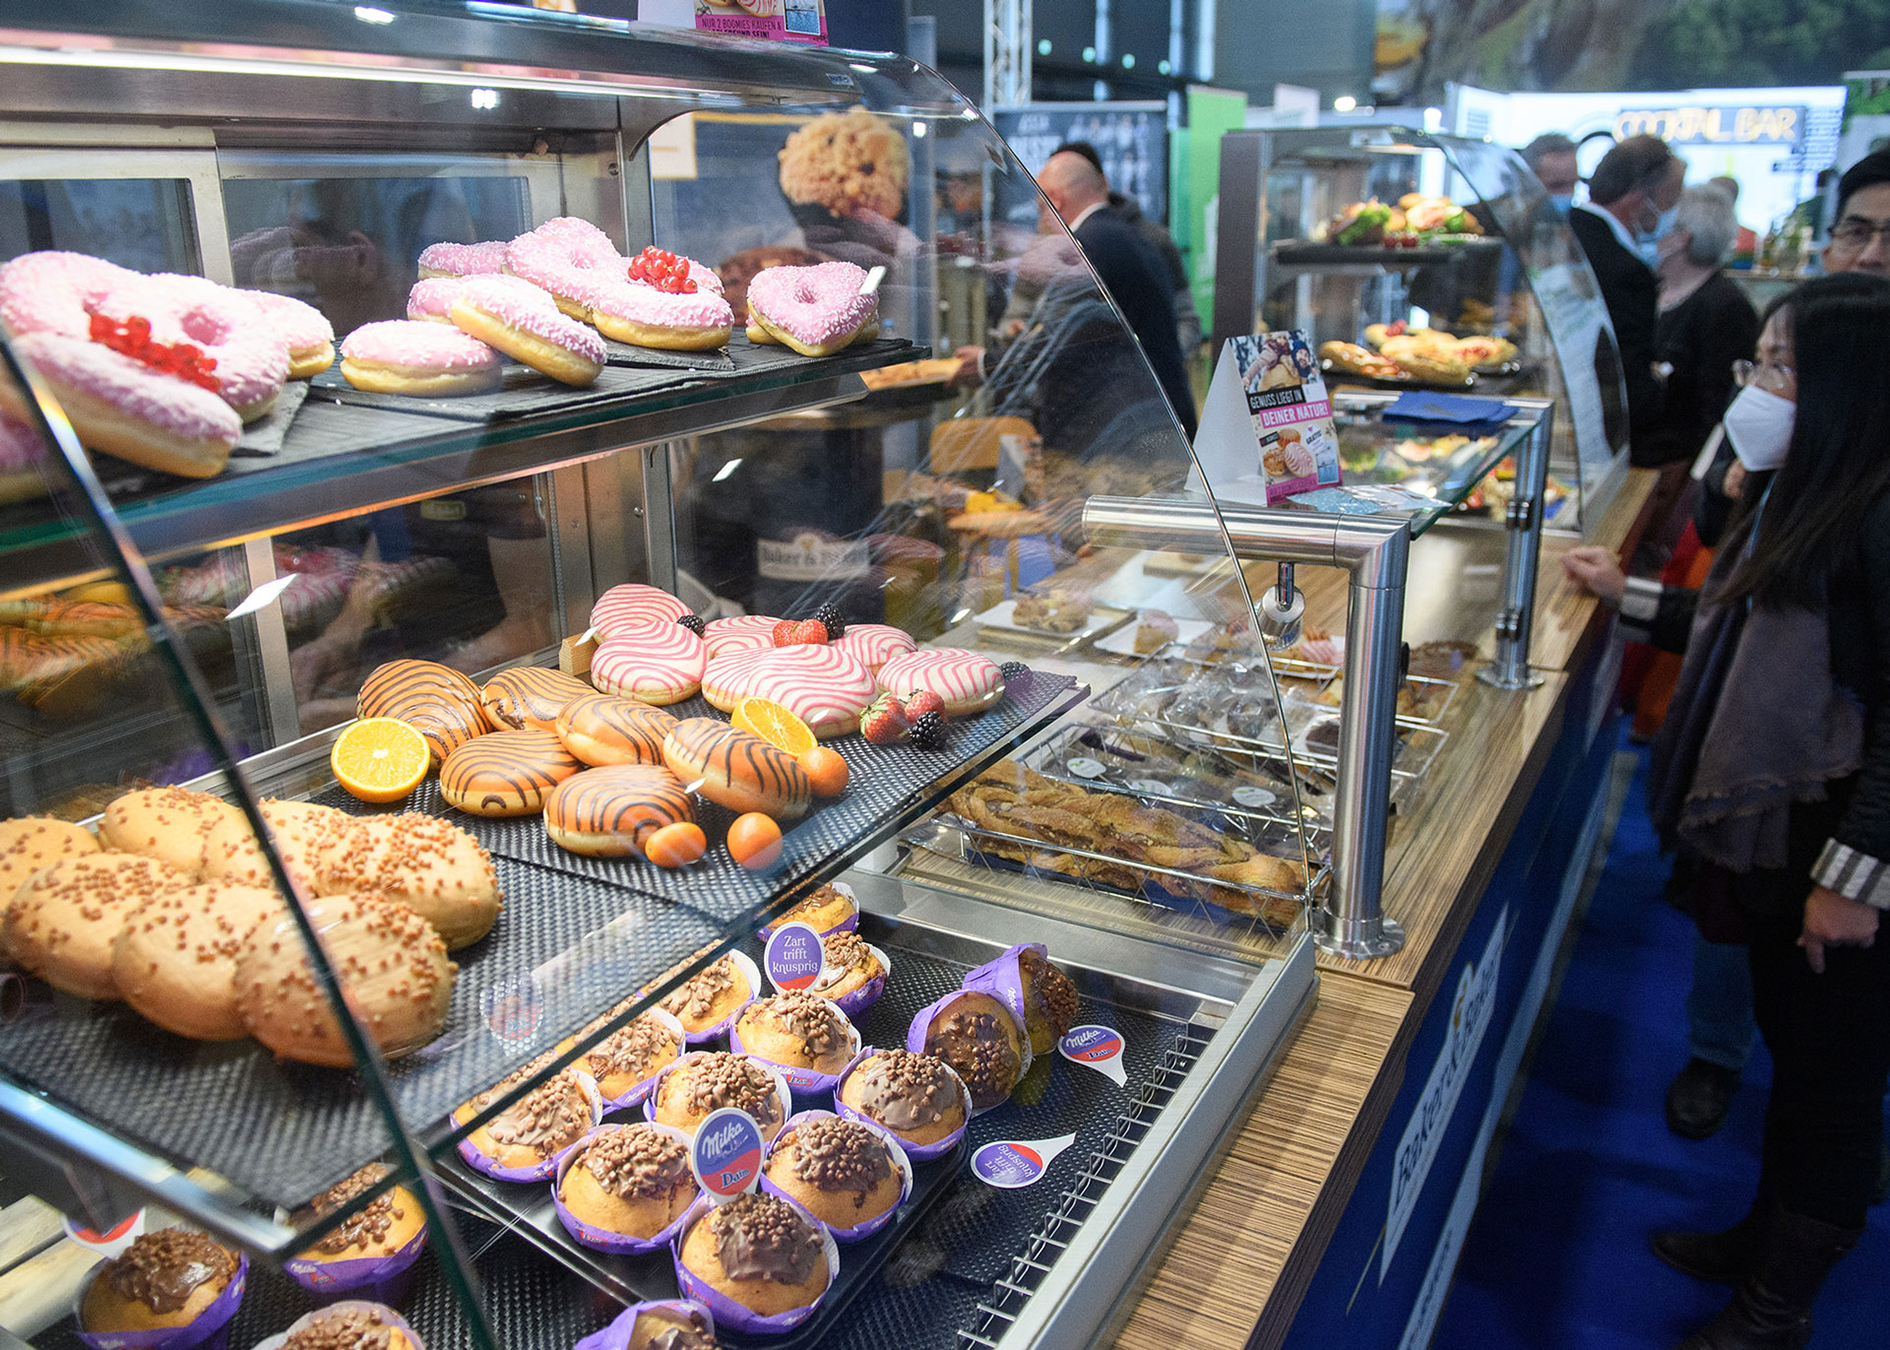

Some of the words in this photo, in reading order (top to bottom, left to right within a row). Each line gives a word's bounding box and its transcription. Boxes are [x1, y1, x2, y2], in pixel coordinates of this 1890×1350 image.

[702, 18, 716, 28] NUR
[717, 19, 722, 28] 2
[751, 20, 776, 30] KAUFEN
[777, 22, 782, 31] &
[1735, 108, 1798, 142] BAR
[1250, 393, 1276, 409] GENUSS
[1276, 390, 1294, 405] LIEGT
[1262, 408, 1296, 426] DEINER
[1296, 402, 1328, 419] NATUR!
[784, 936, 806, 947] Zart
[784, 948, 808, 960] trifft
[772, 960, 818, 974] knusprig
[1066, 1030, 1101, 1048] Milka
[1087, 1048, 1114, 1060] Daim
[702, 1122, 744, 1159] Milka
[984, 1161, 1006, 1179] Zart
[994, 1155, 1017, 1174] trifft
[997, 1145, 1036, 1178] knusprig
[721, 1169, 750, 1189] Daim
